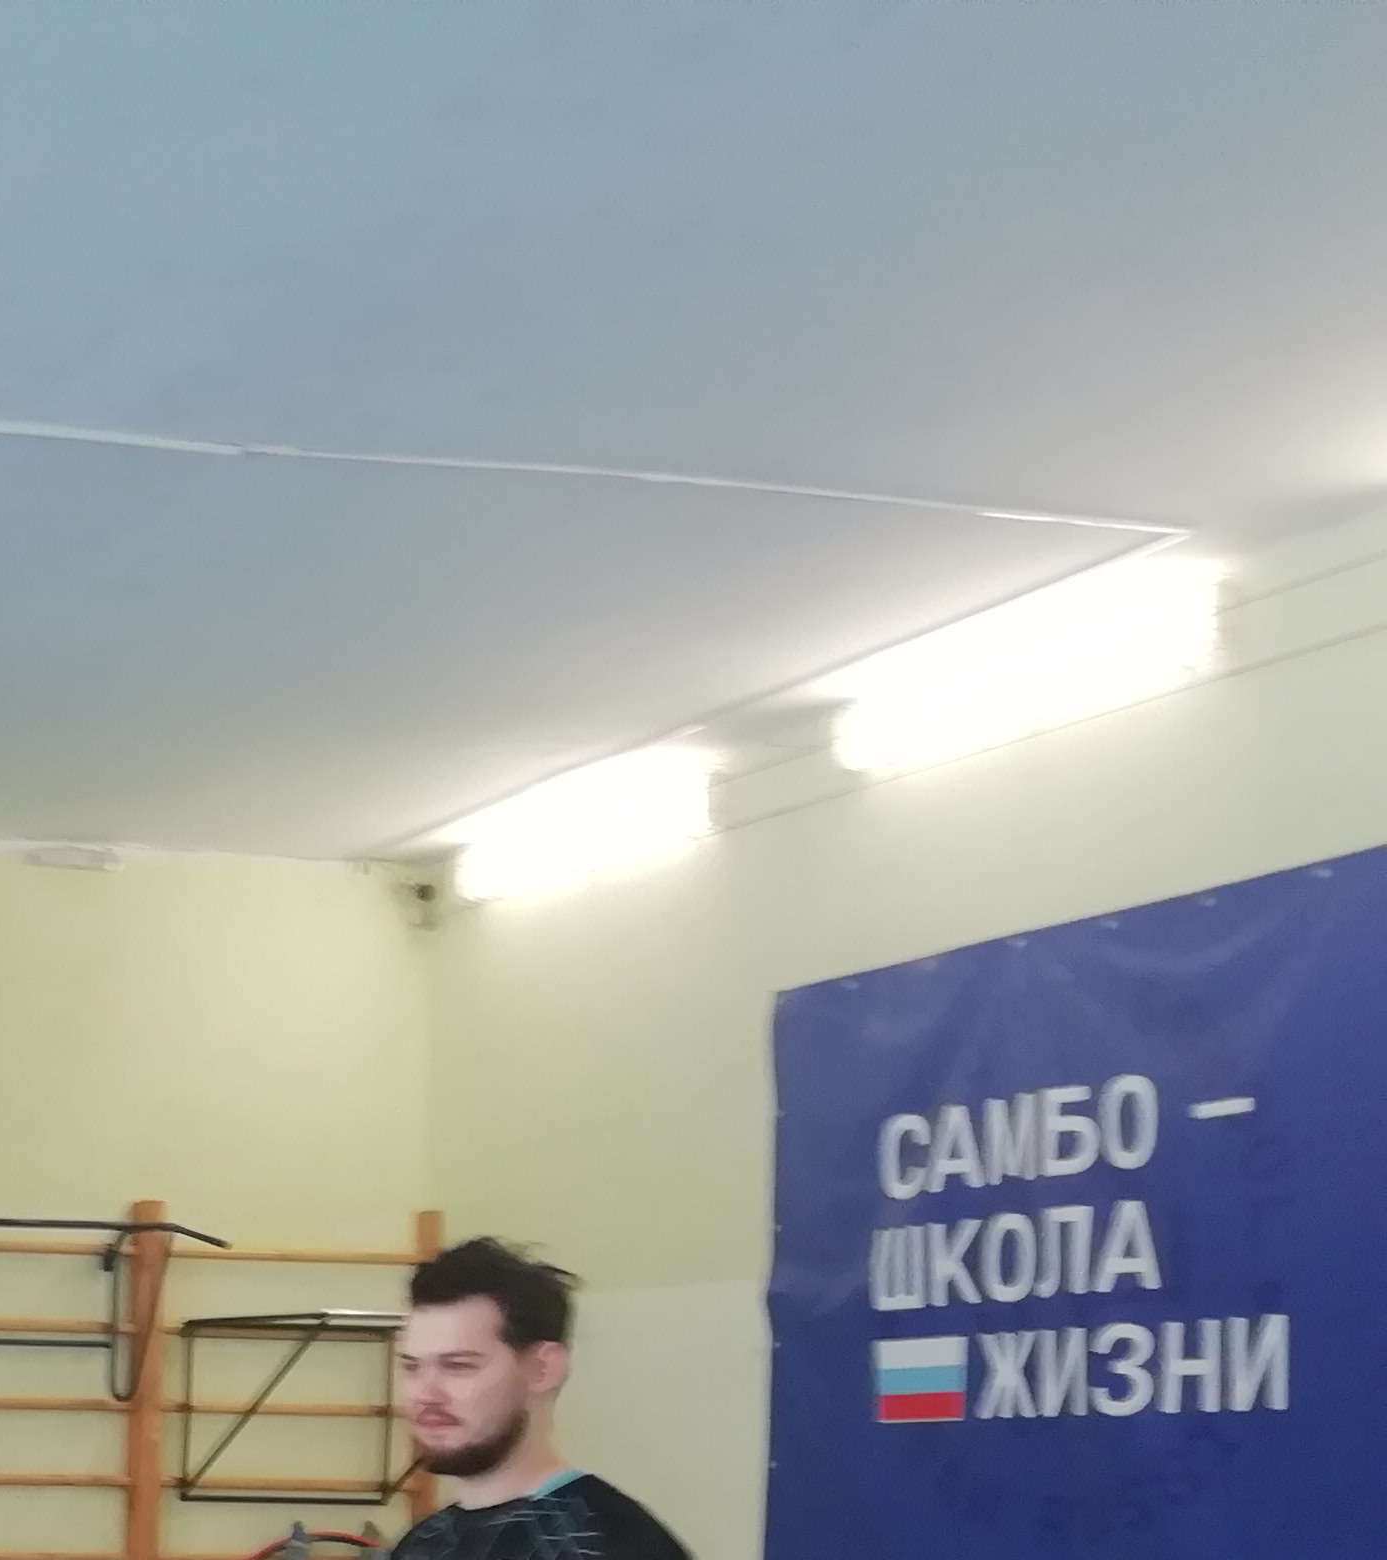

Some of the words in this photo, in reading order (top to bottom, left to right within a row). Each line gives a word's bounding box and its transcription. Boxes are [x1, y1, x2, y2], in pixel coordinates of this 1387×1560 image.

[877, 1073, 1159, 1200] САМБО
[869, 1200, 1162, 1311] ШКОЛА
[975, 1313, 1290, 1419] ЖИЗНИ
